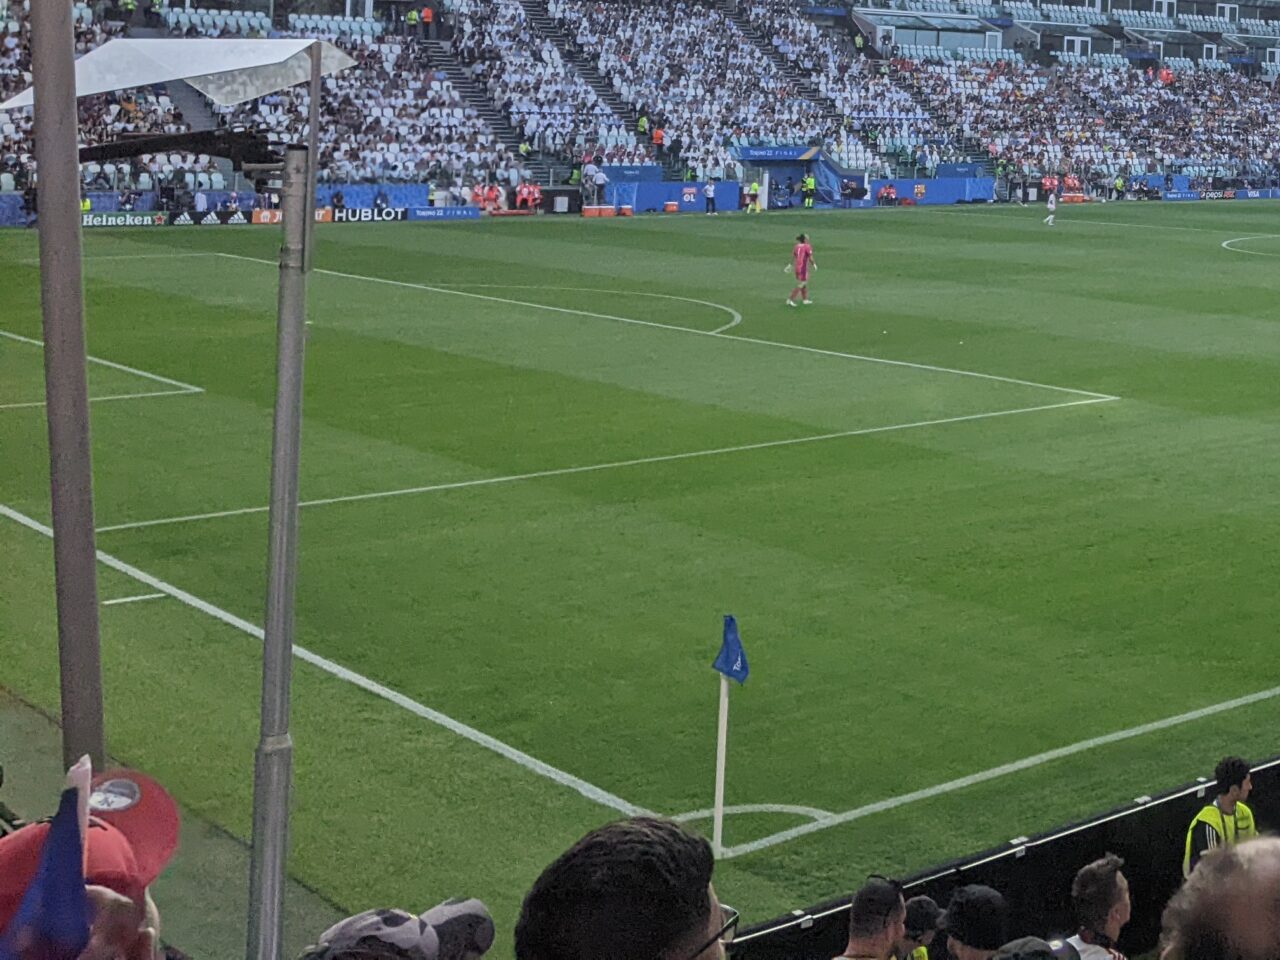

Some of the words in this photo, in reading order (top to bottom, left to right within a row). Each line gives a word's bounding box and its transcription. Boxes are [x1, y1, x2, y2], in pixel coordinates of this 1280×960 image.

[683, 193, 696, 202] OL
[1206, 191, 1223, 200] pepsi
[1247, 190, 1260, 198] VISA
[334, 208, 405, 222] HUBLOT
[82, 213, 153, 227] Heineken
